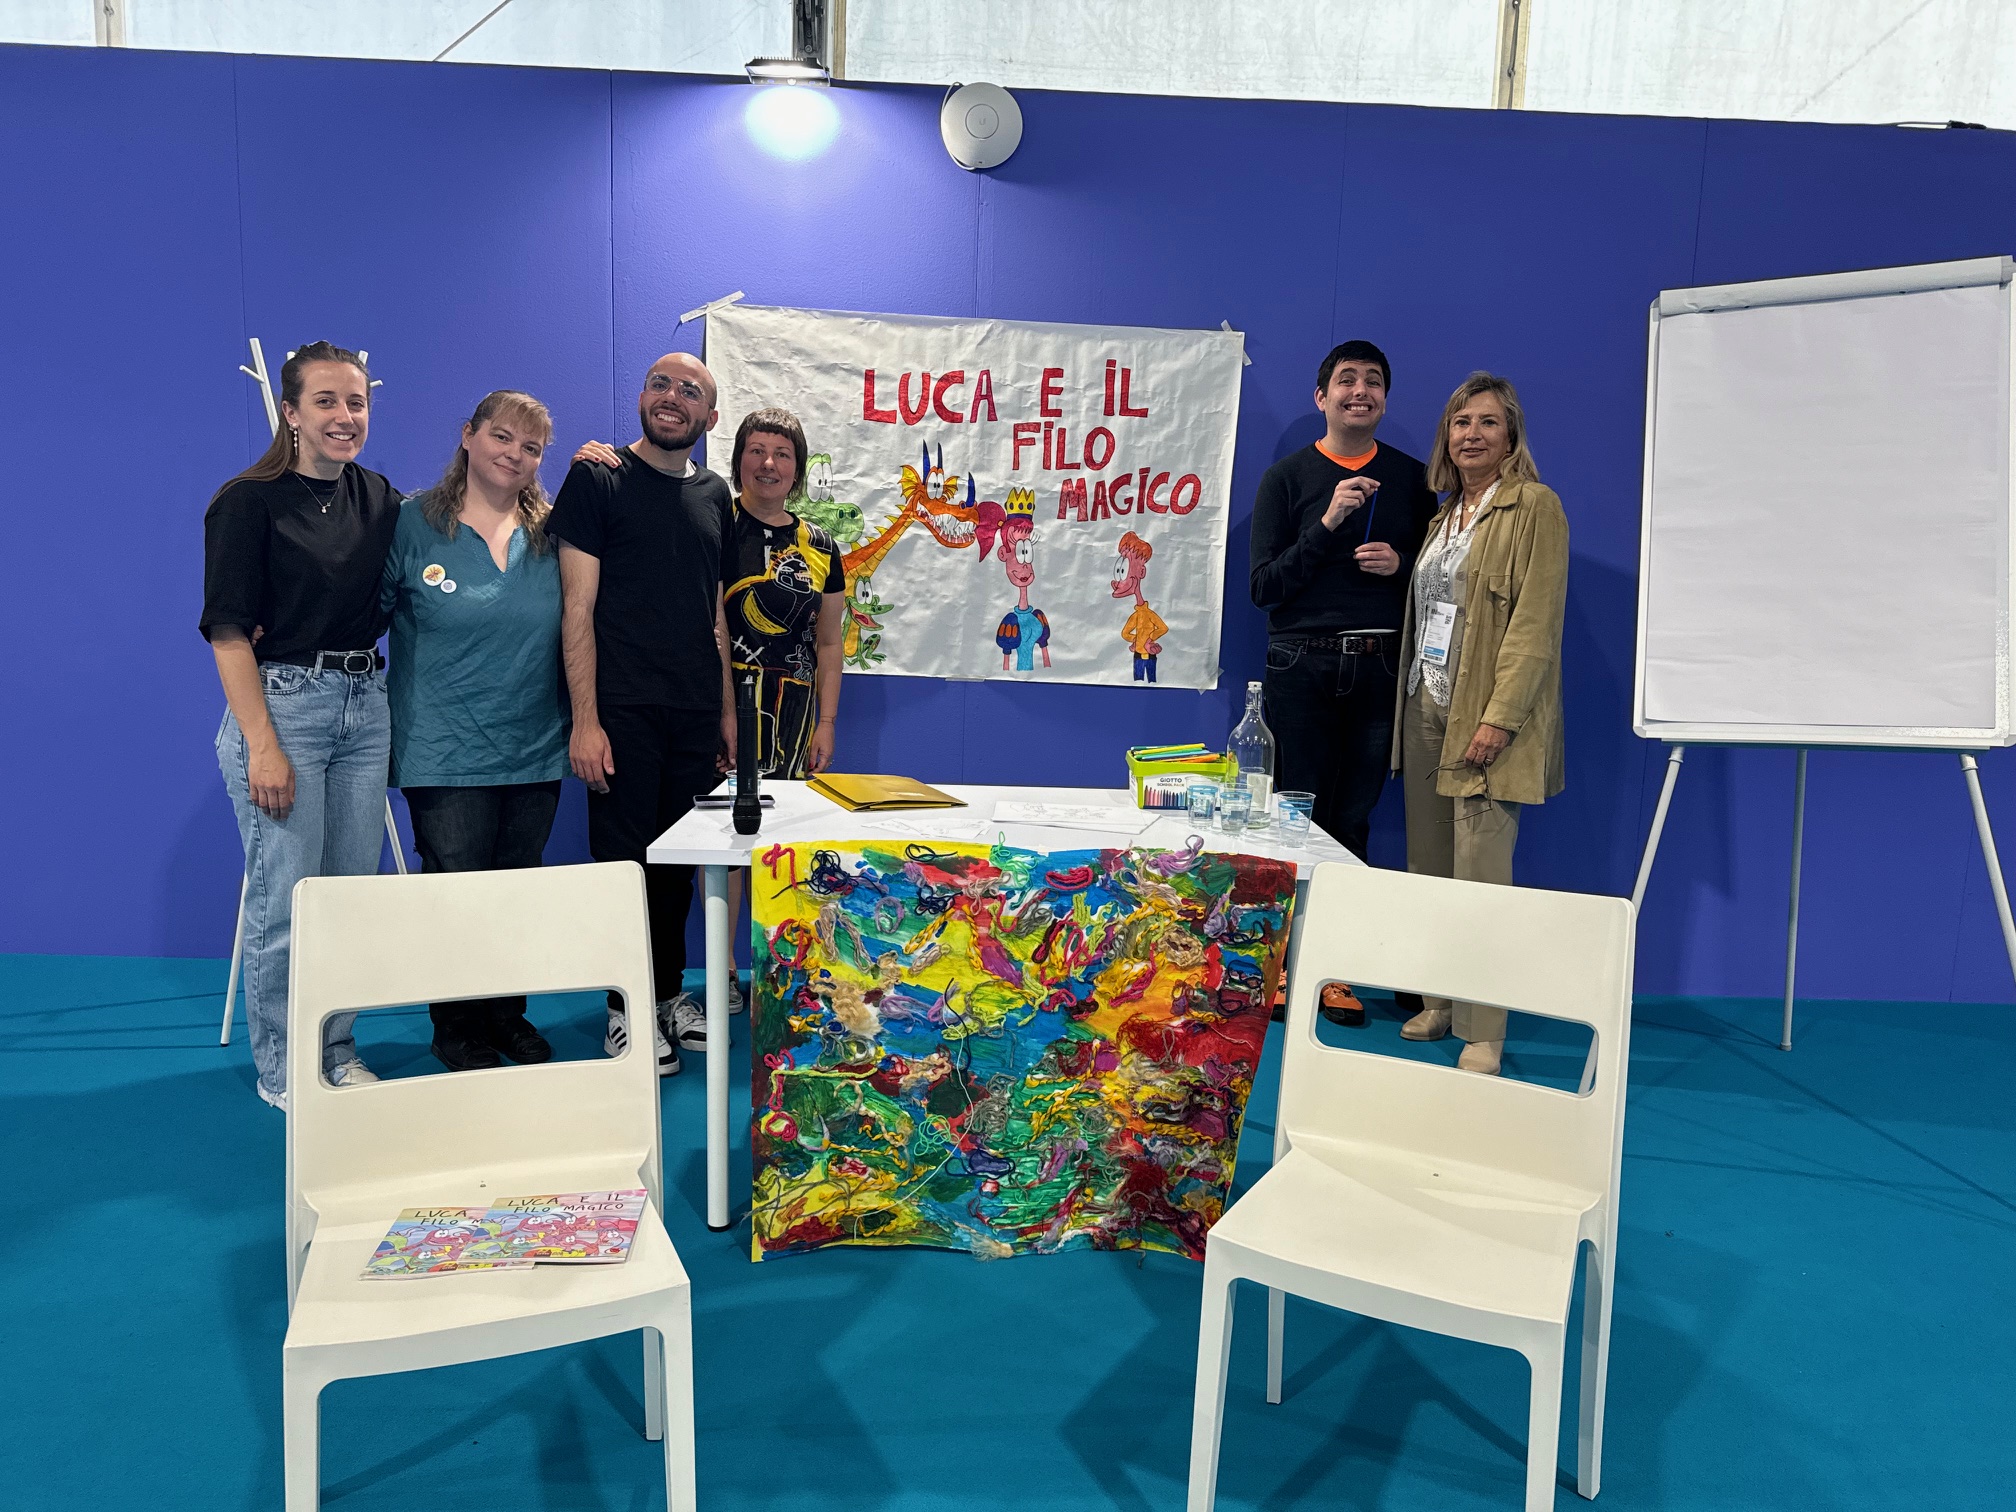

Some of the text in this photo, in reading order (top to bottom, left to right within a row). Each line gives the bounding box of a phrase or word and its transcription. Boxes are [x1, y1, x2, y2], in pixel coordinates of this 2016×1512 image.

[862, 368, 998, 425] LUCA
[1040, 367, 1065, 418] E
[508, 1197, 558, 1206] LUCA
[563, 1203, 624, 1211] MAGICO
